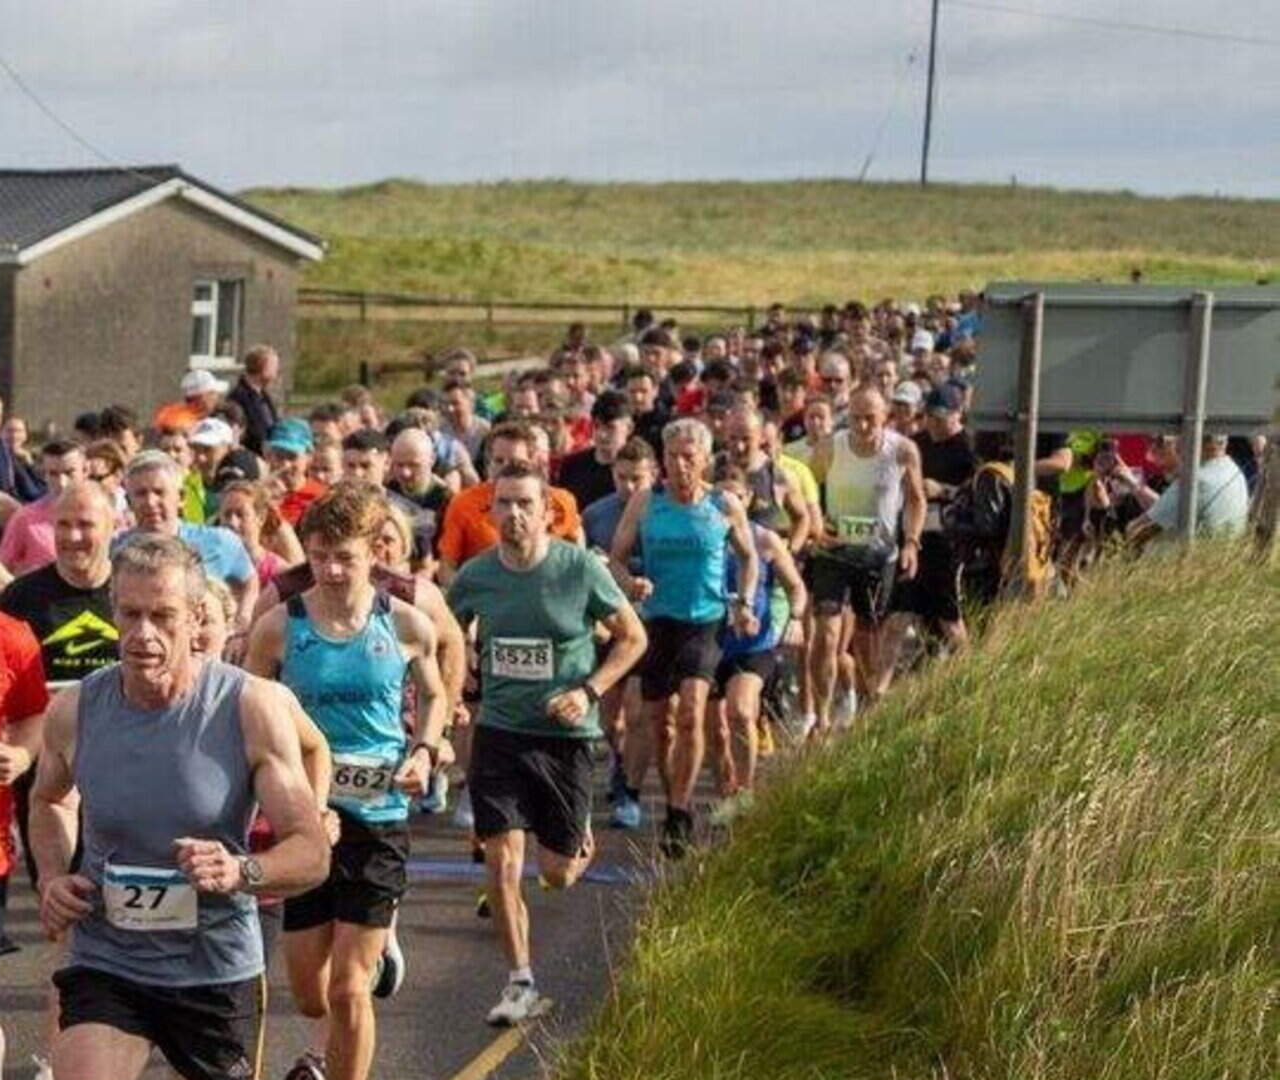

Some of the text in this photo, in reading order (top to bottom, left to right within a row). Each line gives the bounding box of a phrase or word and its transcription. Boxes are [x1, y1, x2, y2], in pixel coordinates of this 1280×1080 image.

[495, 649, 549, 666] 6528
[335, 766, 386, 790] 662
[124, 885, 168, 911] 27
